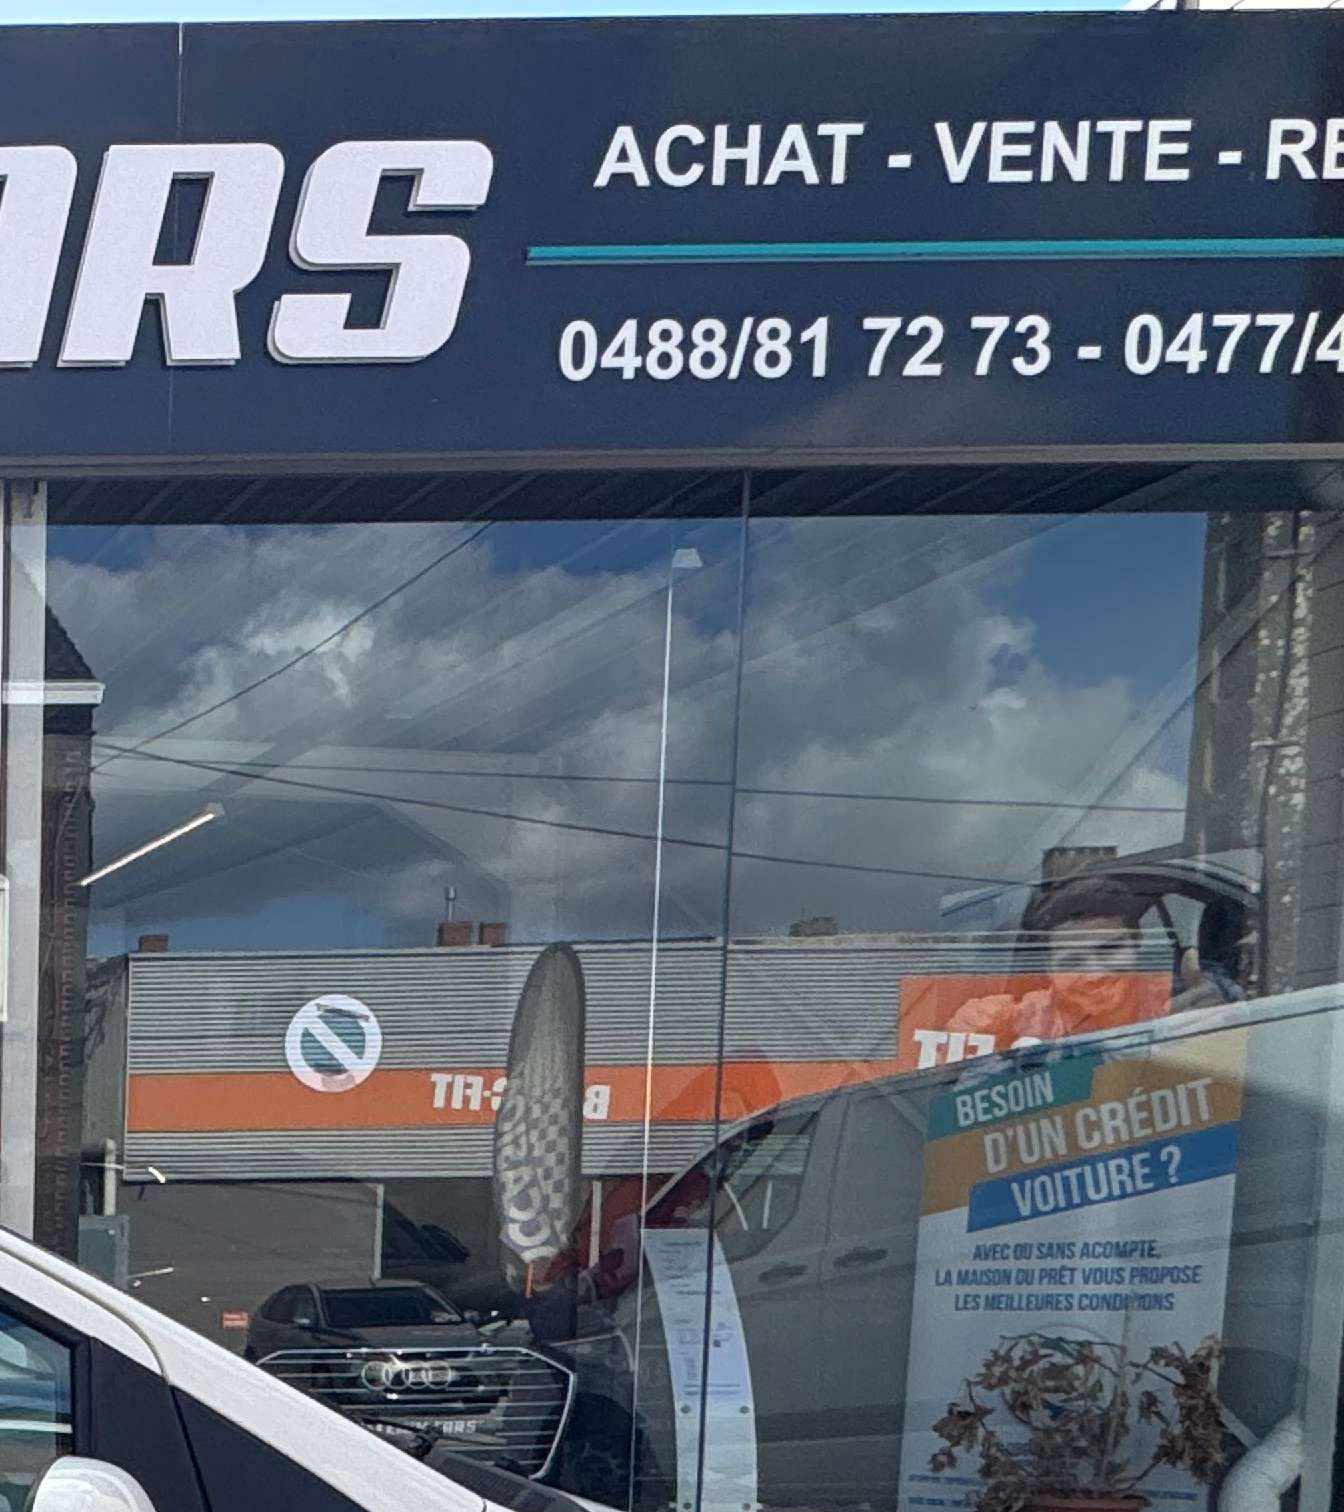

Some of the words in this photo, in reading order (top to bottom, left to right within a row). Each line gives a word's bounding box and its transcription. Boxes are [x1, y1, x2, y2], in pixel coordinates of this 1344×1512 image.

[593, 122, 865, 188] ACHAT
[933, 118, 1193, 184] VENTE
[558, 316, 830, 382] 0488/81
[862, 316, 945, 377] 72
[969, 314, 1052, 377] 73
[955, 1072, 1055, 1127] BESOIN
[983, 1115, 1068, 1174] D'UN
[1073, 1077, 1214, 1151] CRÉDIT
[1012, 1151, 1155, 1217] VOITURE
[935, 1269, 953, 1286] LA
[956, 1267, 1012, 1286] MAISON
[1014, 1267, 1036, 1286] DU
[1038, 1264, 1078, 1285] PRÊT
[1082, 1266, 1126, 1284] VOUS
[1128, 1265, 1203, 1284] PROPOSE
[973, 1243, 1010, 1261] AVEC
[1013, 1243, 1035, 1261] OU
[1036, 1241, 1077, 1260] SANS
[954, 1294, 980, 1312] LES
[983, 1292, 1074, 1312] MEILLEURES
